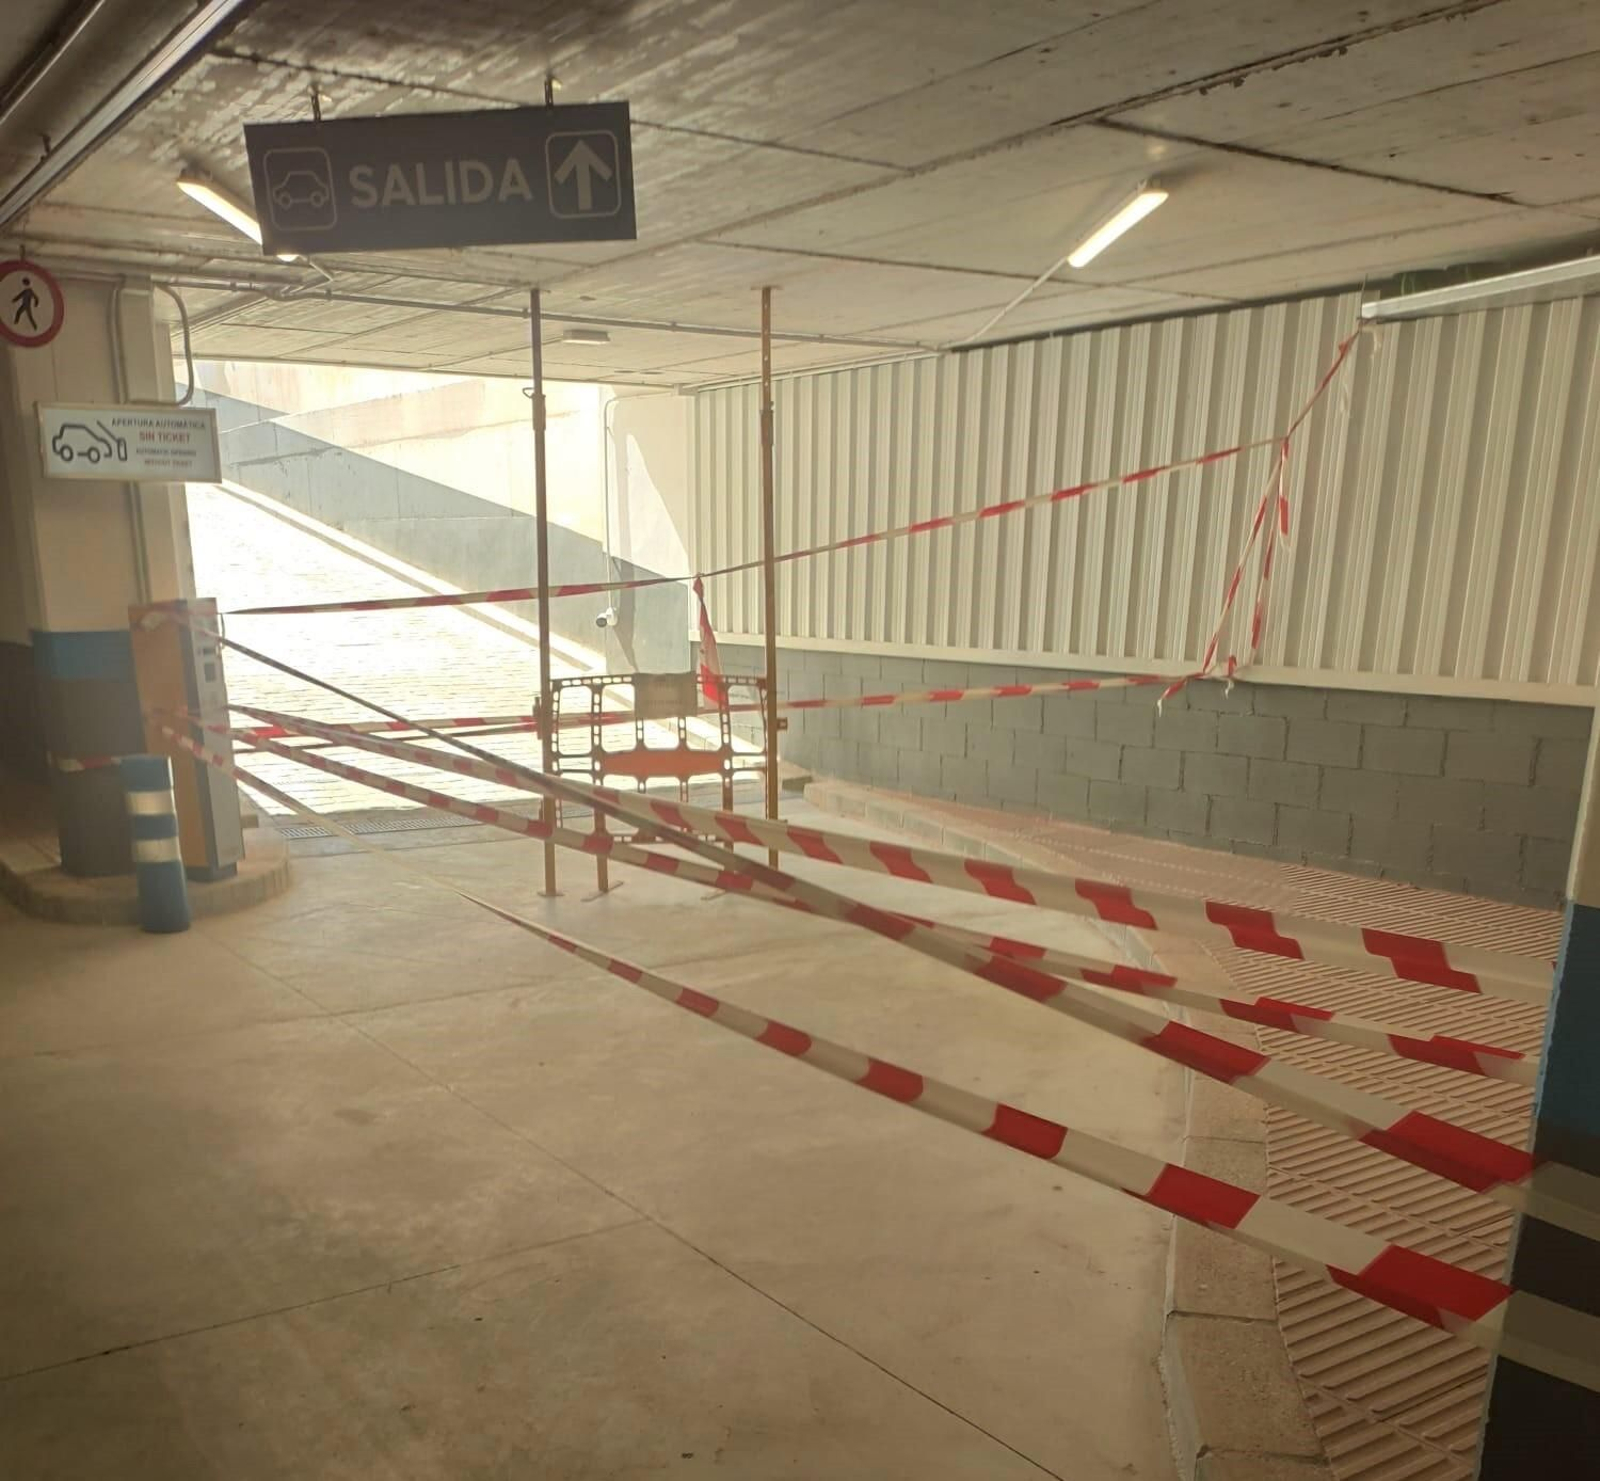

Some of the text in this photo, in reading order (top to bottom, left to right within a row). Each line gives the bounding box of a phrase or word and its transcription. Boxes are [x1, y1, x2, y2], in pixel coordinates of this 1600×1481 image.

[349, 157, 533, 208] SALIDA
[112, 417, 153, 427] APERTURA
[139, 431, 190, 443] SIN TICKET
